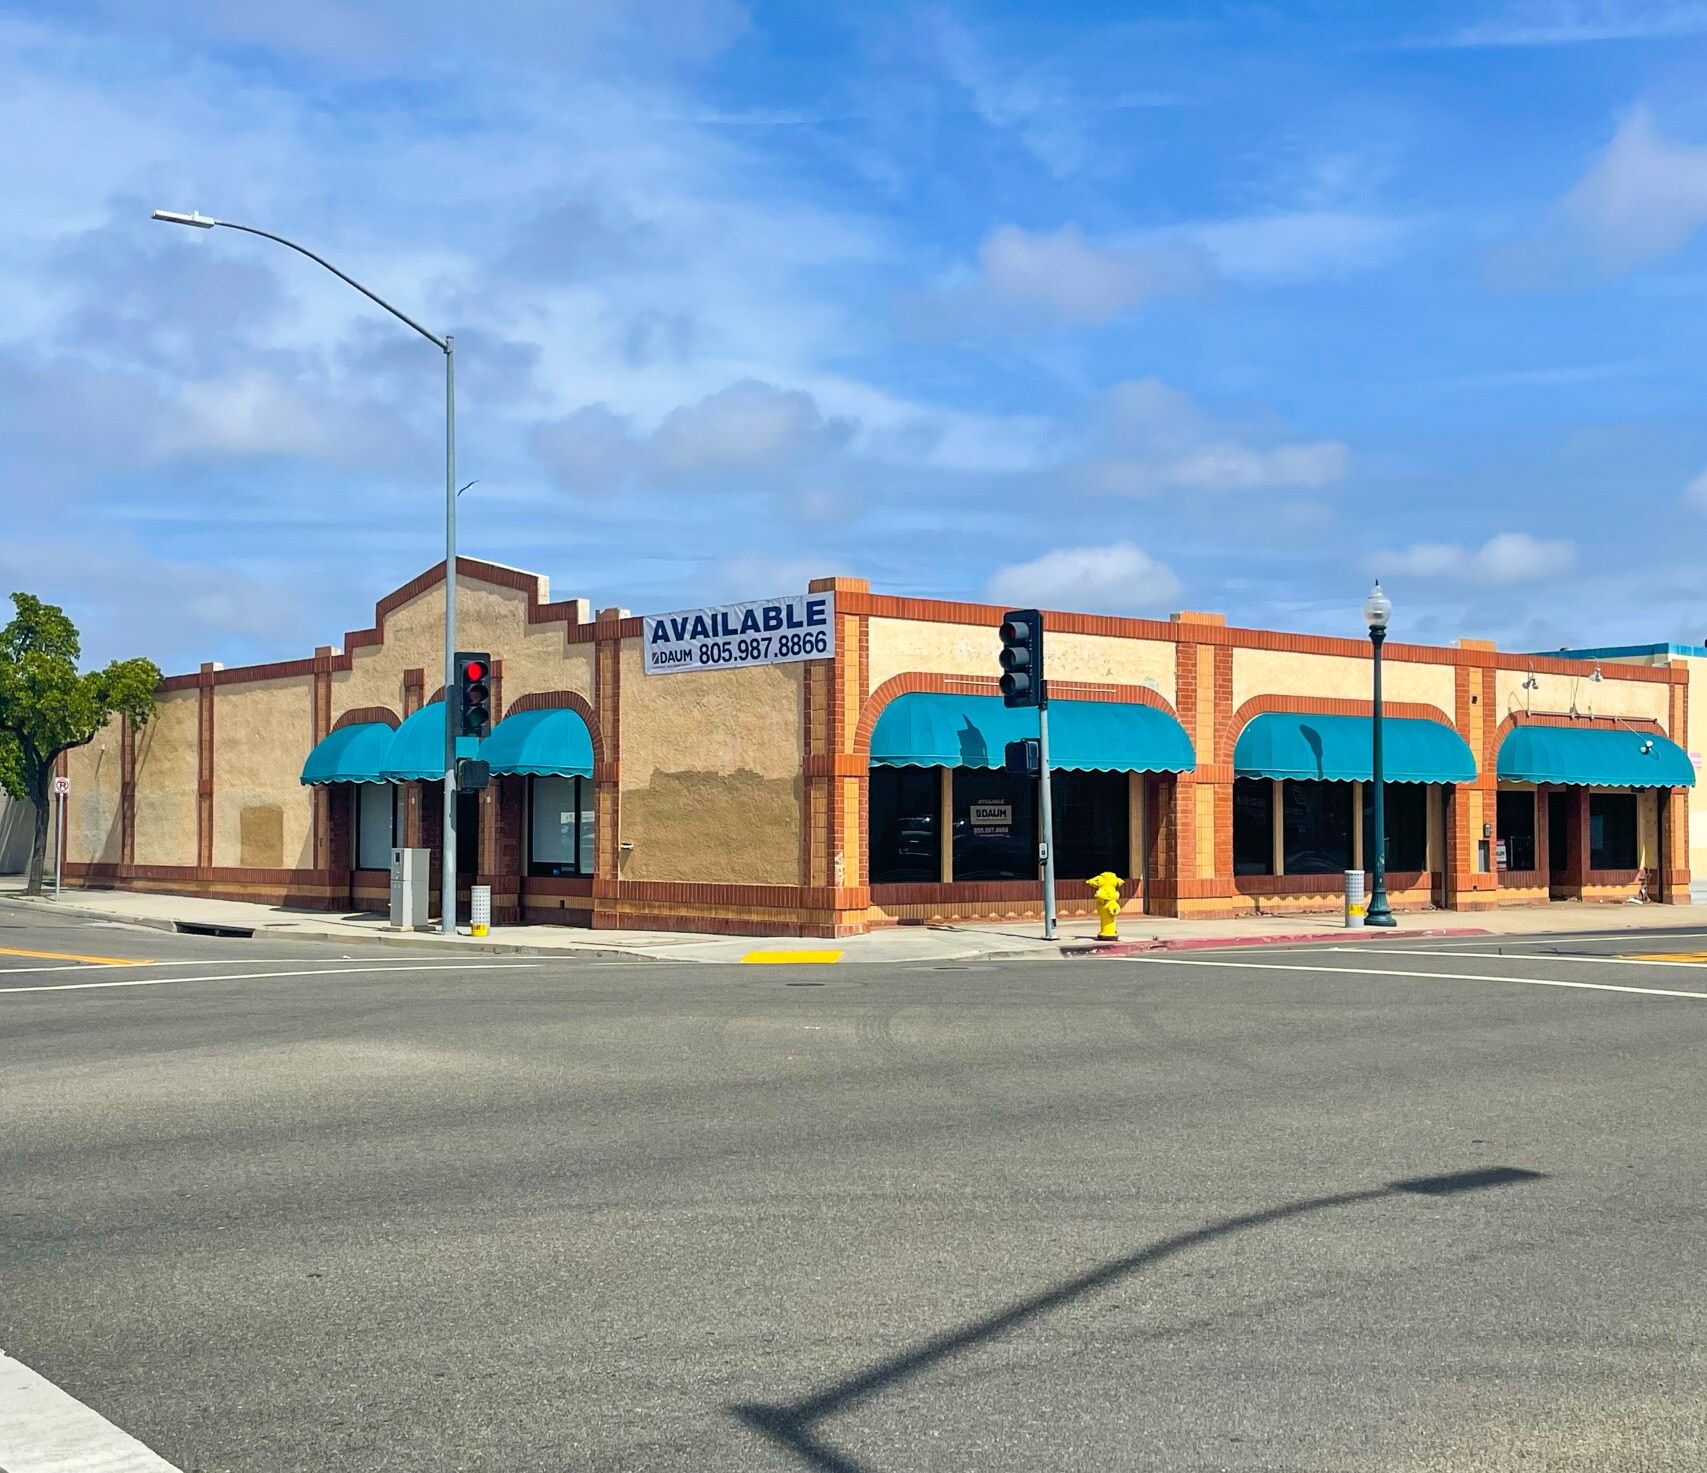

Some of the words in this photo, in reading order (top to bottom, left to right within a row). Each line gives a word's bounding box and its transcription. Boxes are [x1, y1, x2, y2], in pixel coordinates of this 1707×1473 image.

[651, 599, 827, 644] AVAILABLE
[660, 648, 693, 664] DAUM
[699, 630, 827, 664] 805.987.8866
[981, 809, 1007, 818] DAUM
